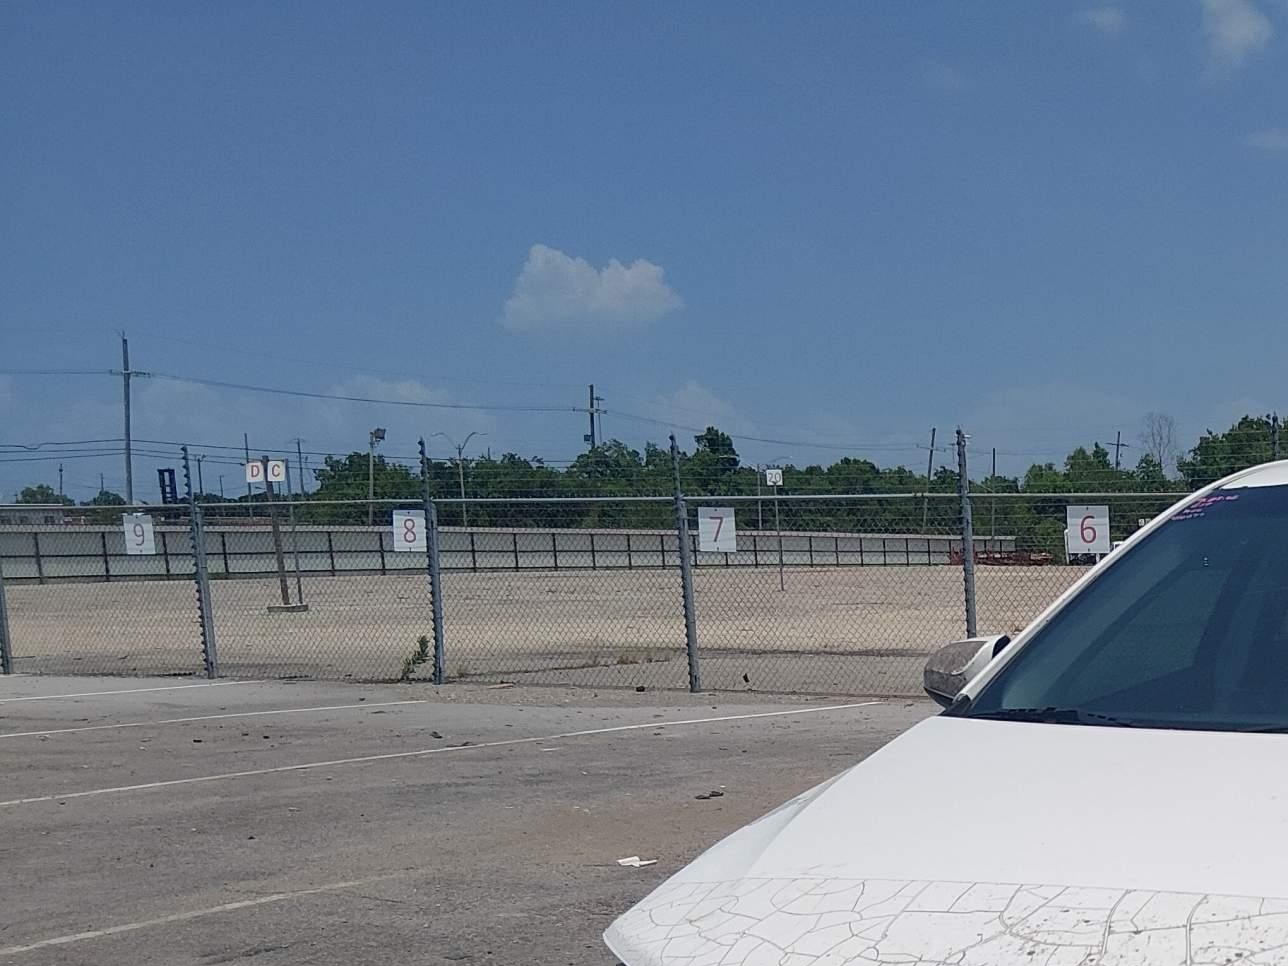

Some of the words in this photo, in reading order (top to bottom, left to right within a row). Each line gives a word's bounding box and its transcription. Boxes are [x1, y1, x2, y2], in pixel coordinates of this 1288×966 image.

[250, 464, 260, 478] D
[271, 463, 281, 478] C
[768, 472, 781, 484] 20
[133, 523, 145, 546] 9
[403, 518, 417, 543] 8
[709, 516, 724, 542] 7
[1080, 515, 1097, 543] 6
